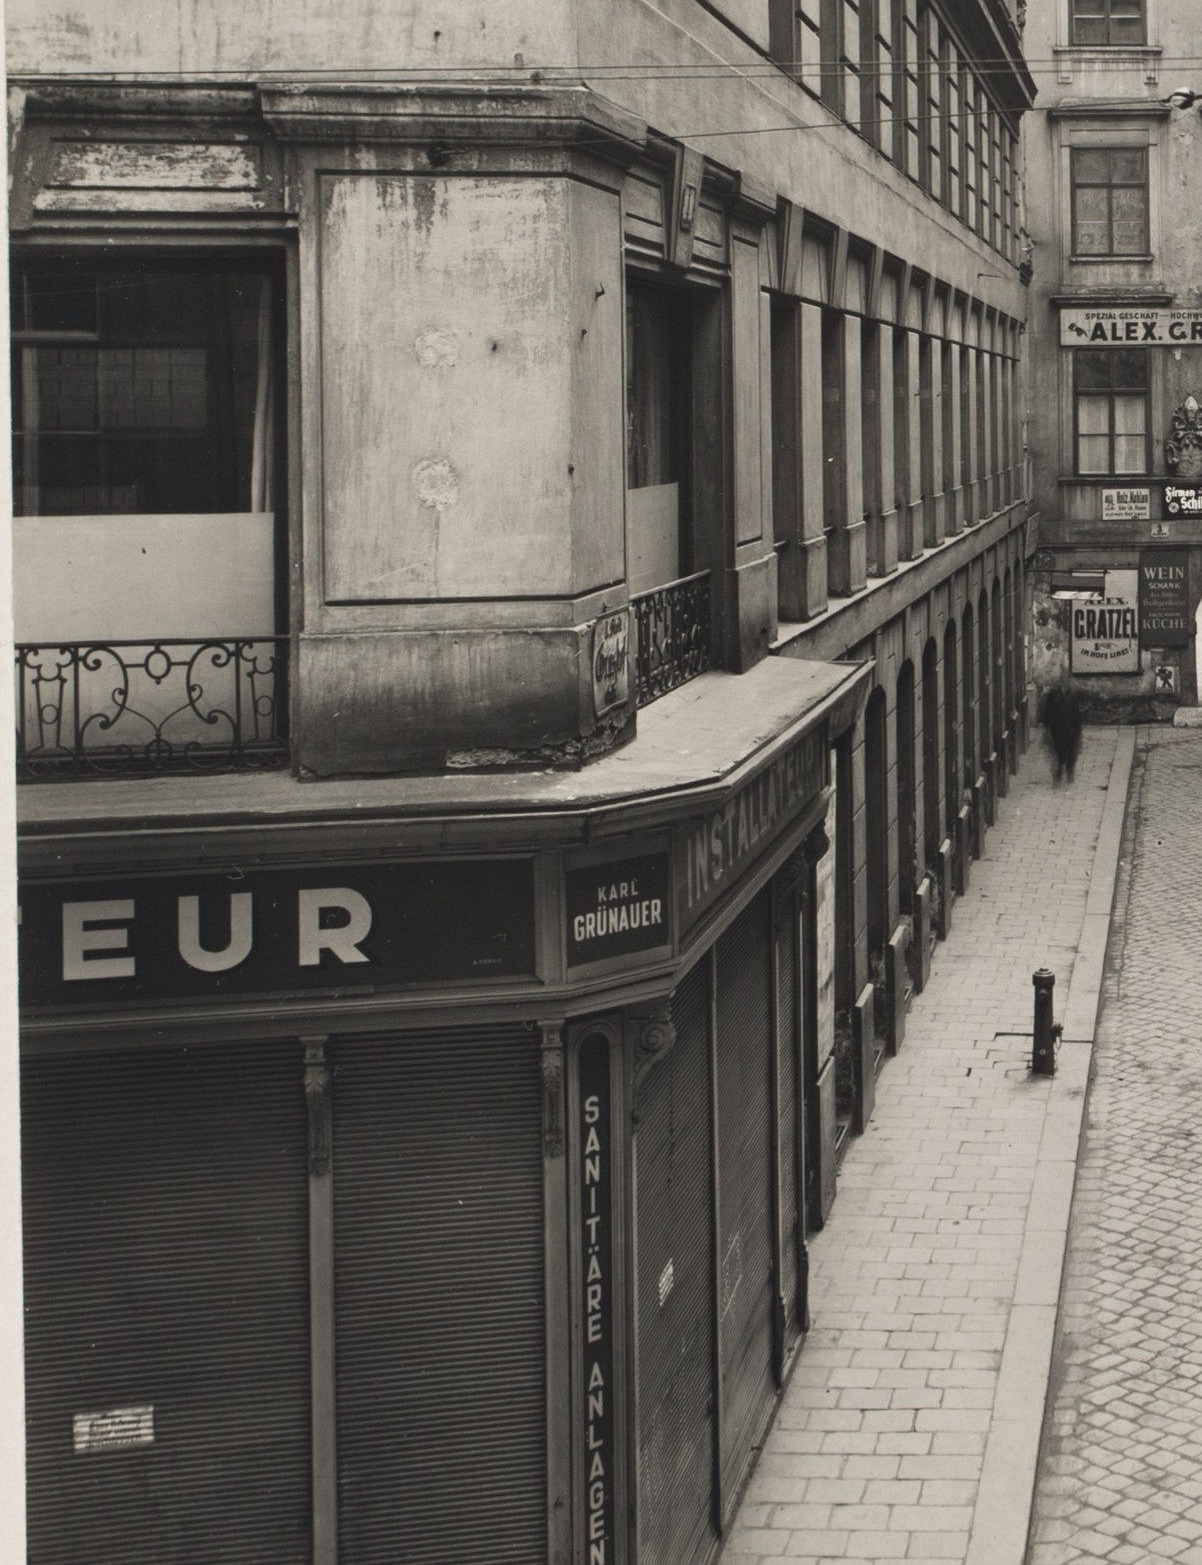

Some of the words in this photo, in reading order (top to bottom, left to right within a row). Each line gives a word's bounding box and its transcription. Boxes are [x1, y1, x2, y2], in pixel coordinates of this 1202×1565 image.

[1090, 321, 1163, 341] ALEX.
[1143, 566, 1184, 580] WEIN
[597, 880, 639, 903] KARL
[17, 886, 372, 981] EUR
[573, 898, 663, 942] GRÜNAUER
[583, 1095, 603, 1344] SANITÄRE
